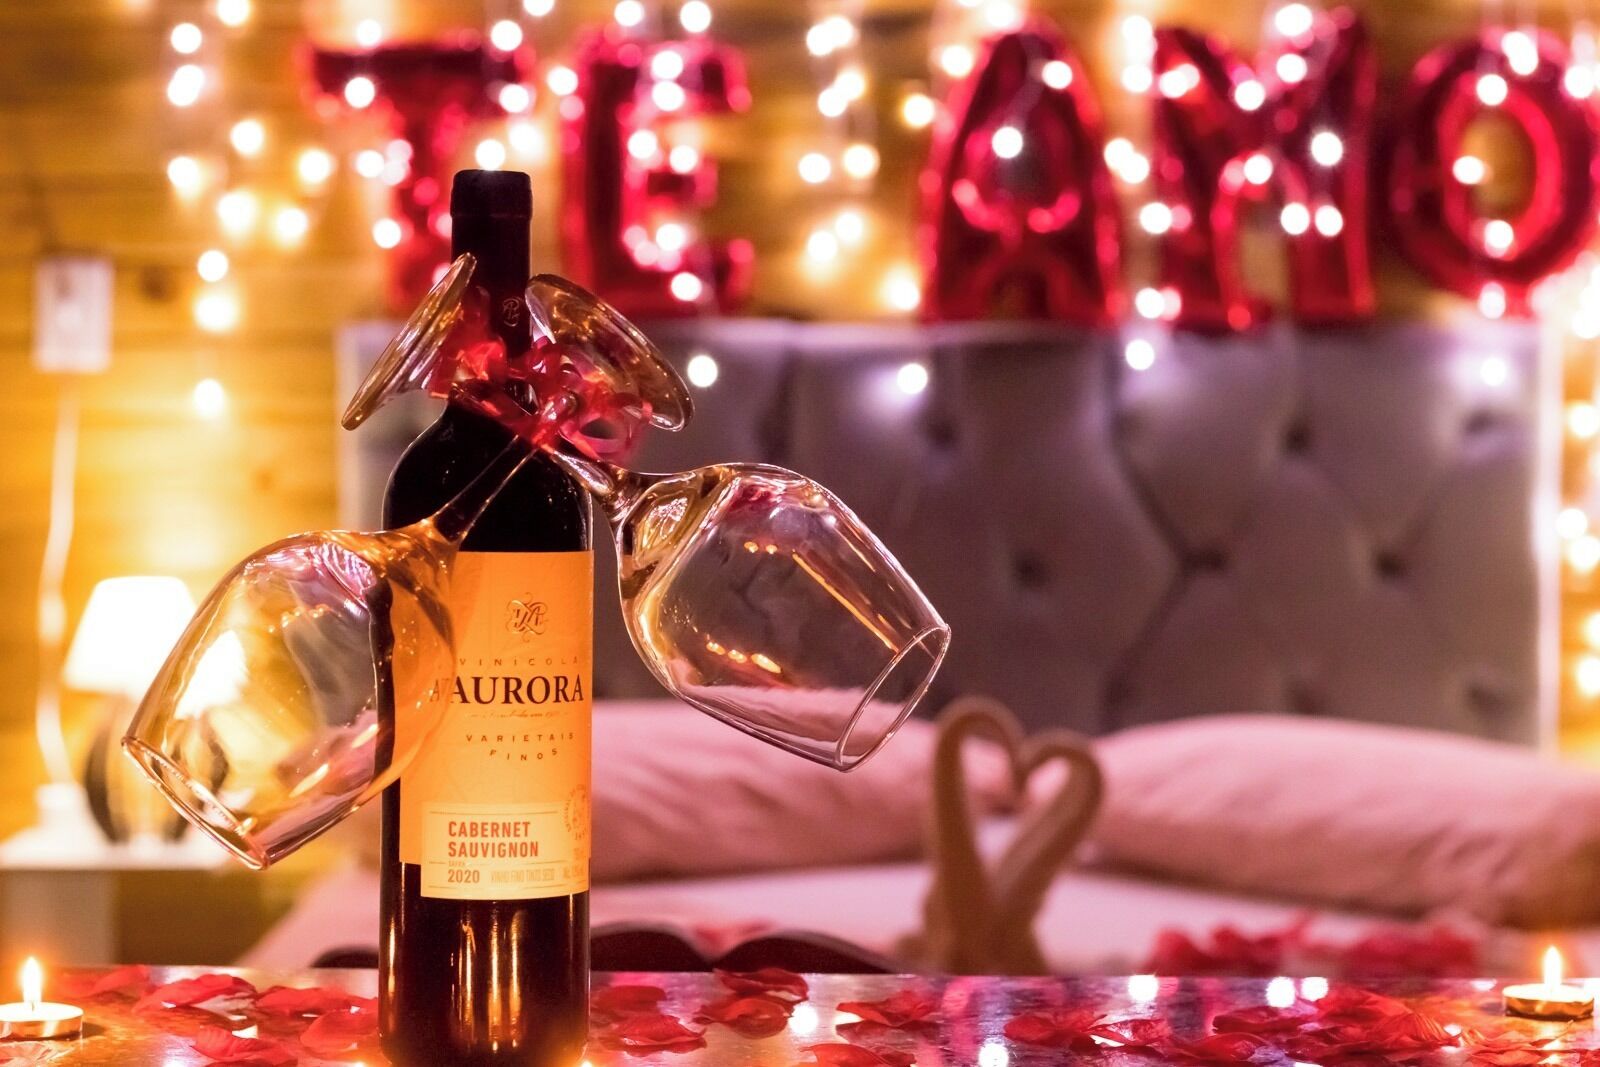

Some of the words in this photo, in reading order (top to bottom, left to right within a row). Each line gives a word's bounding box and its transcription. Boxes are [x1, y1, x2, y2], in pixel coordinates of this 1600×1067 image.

[298, 25, 756, 320] TE
[916, 6, 1599, 332] AMO
[453, 673, 585, 705] AURORA
[466, 733, 574, 742] VARIETAIS
[489, 749, 558, 761] FINOS
[448, 821, 531, 838] CABERNET
[448, 841, 539, 858] SAUVIGNON
[447, 869, 480, 883] 2020
